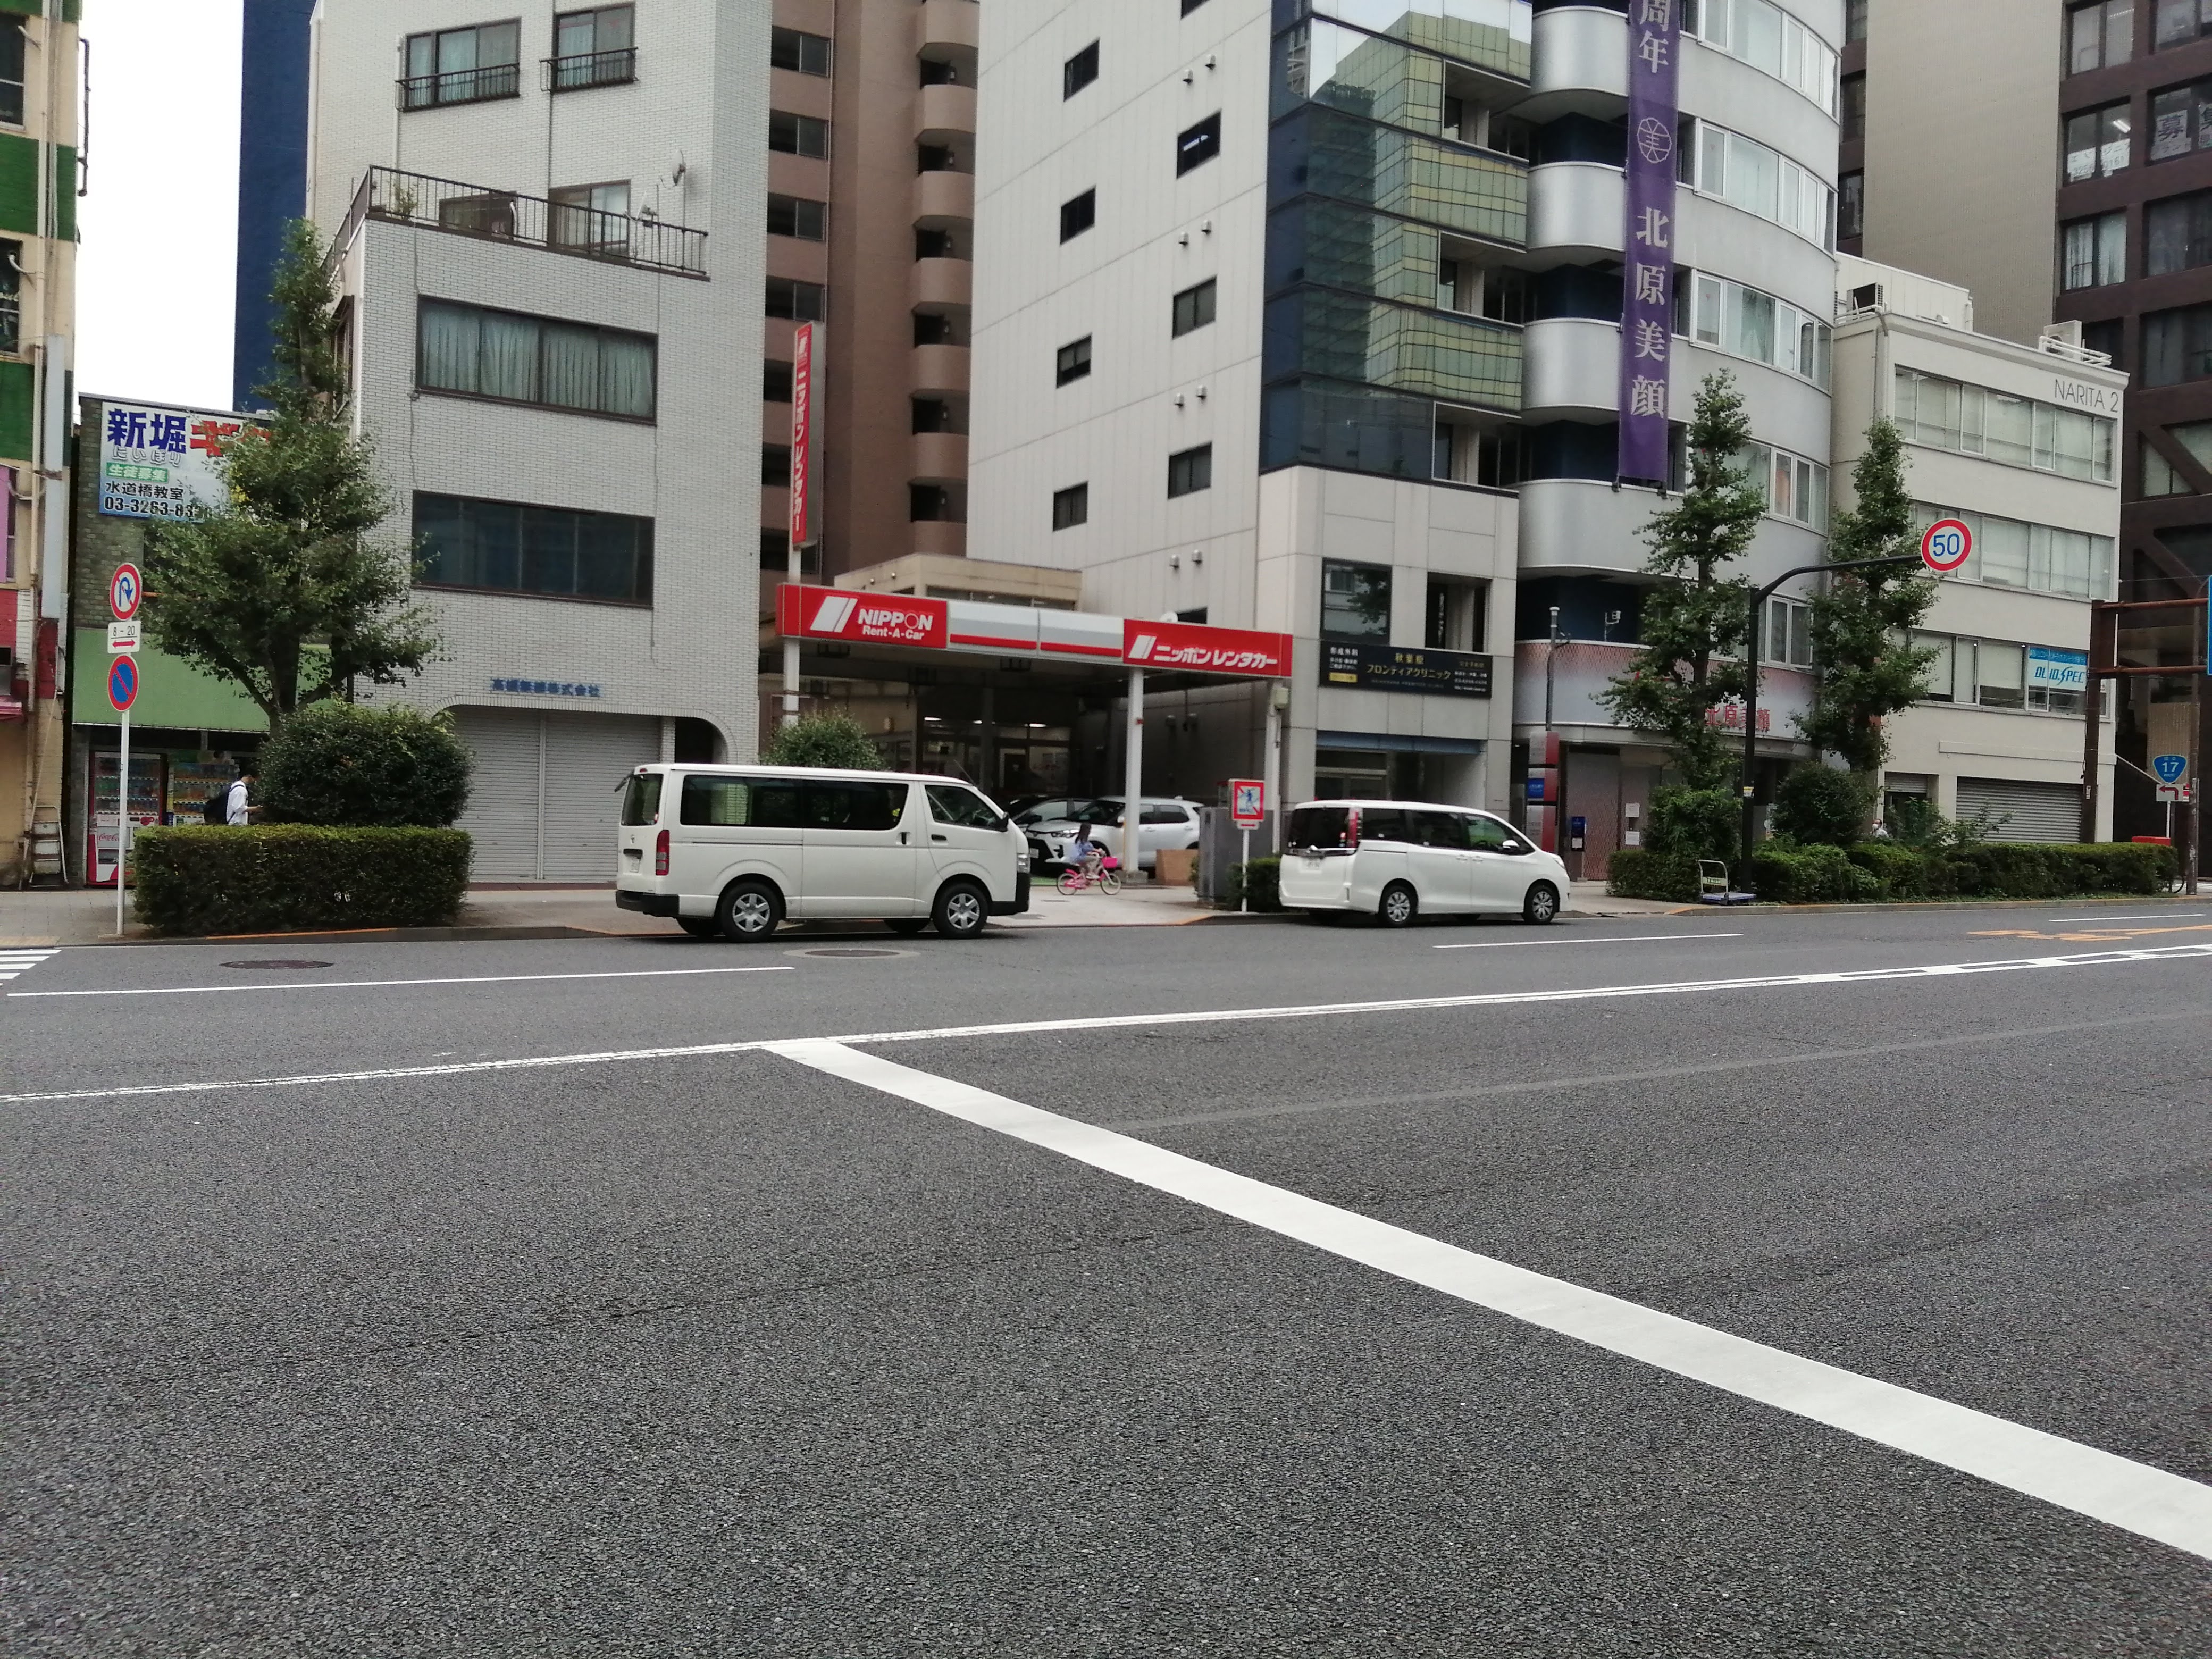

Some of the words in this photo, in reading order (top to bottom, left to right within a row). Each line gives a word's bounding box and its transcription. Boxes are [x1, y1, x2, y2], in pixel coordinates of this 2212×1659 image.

[1630, 206, 1670, 419] 北原美顔
[2055, 379, 2105, 410] NARITA
[2110, 391, 2118, 413] 2
[109, 464, 167, 481] 生徒募集
[105, 480, 184, 500] 水道橋教室
[105, 496, 212, 518] 03-3263-83
[1933, 533, 1960, 557] 50
[858, 608, 933, 631] NIPPON
[1154, 645, 1278, 669] ニッポンレンタカー
[1367, 664, 1451, 680] フロンティアクリニック
[2162, 761, 2179, 773] 17
